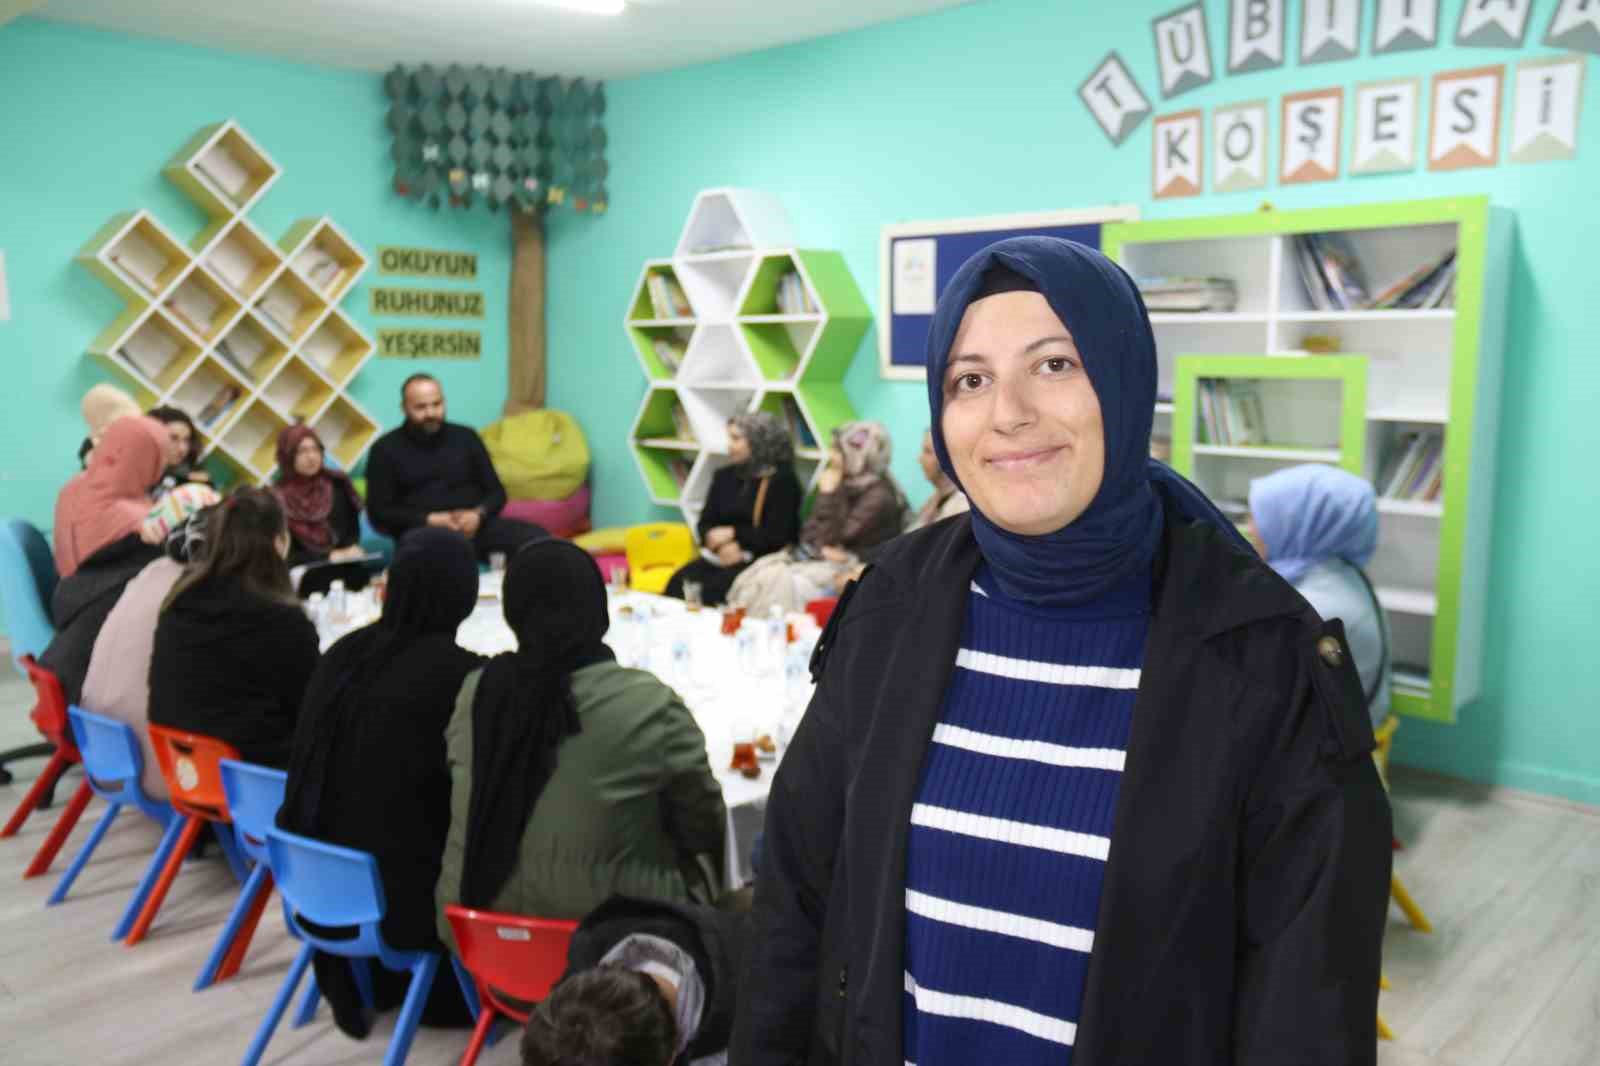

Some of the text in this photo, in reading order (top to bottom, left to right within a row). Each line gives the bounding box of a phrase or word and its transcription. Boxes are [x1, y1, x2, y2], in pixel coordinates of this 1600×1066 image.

[1164, 76, 1554, 169] KÖŞESİ
[381, 248, 477, 276] OKUYUN
[374, 289, 481, 314] RUHUNUZ
[381, 332, 480, 358] YEŞERSİN
